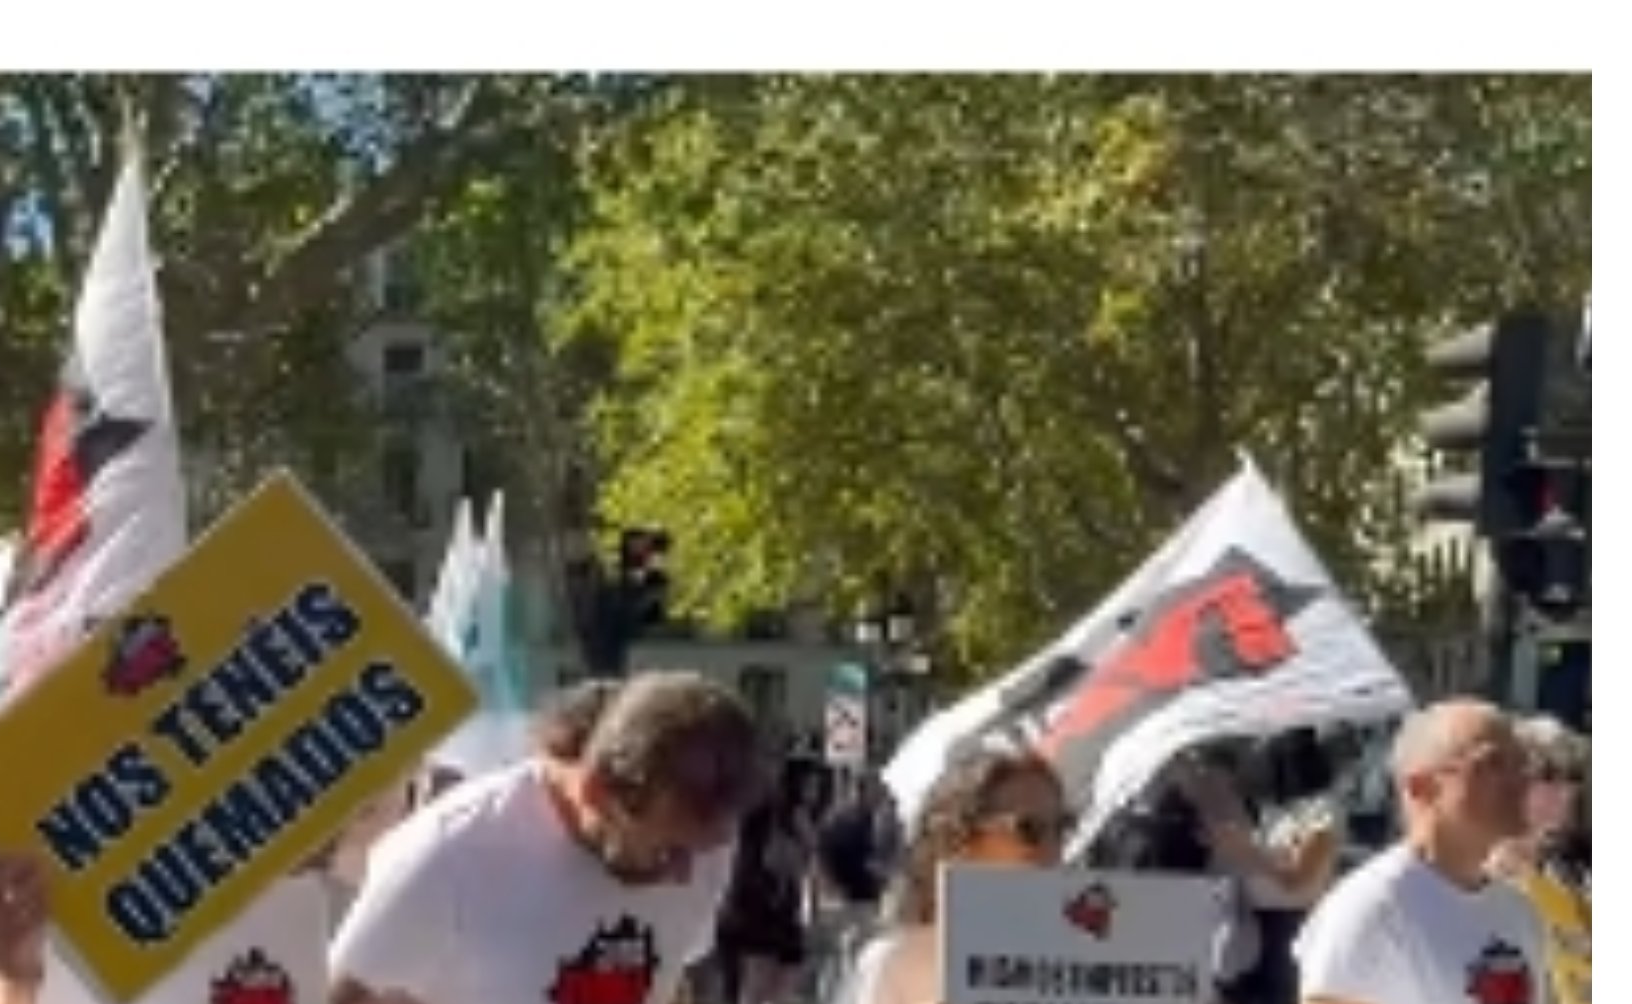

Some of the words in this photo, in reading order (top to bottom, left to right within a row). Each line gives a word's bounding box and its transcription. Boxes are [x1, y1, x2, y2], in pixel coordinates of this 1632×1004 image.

[37, 742, 170, 871] NOS
[153, 582, 360, 767] TENÉIS
[106, 662, 425, 945] QUEMADOS
